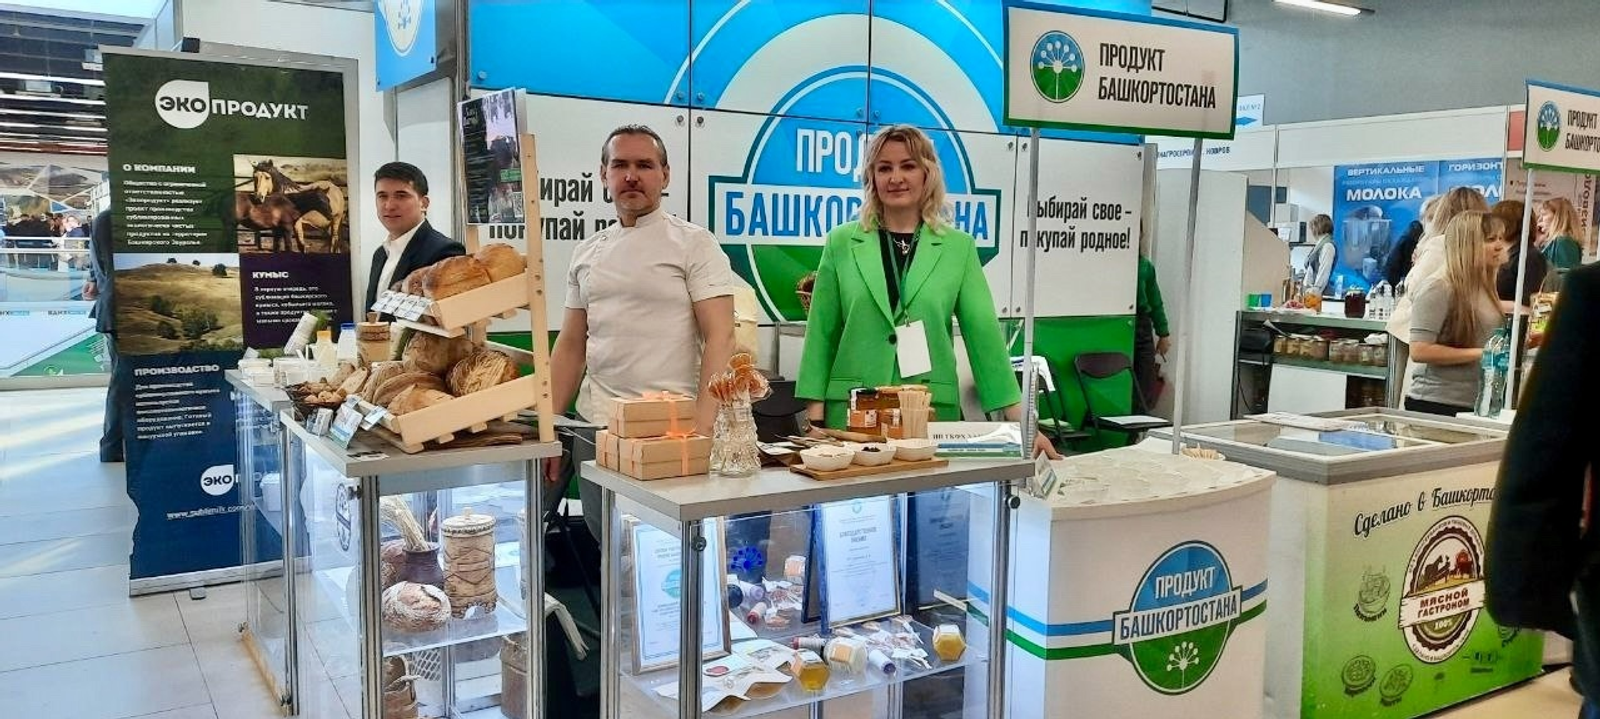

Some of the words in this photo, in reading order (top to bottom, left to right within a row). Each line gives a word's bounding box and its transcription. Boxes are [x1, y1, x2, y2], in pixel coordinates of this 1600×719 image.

[1099, 42, 1166, 73] ПРОДУКТ
[1098, 76, 1216, 109] БАШКОРТОСТАНА
[1567, 110, 1598, 130] ПРОДУКТ
[122, 163, 132, 172] О
[133, 164, 196, 174] КОМПАНИИ
[1347, 165, 1425, 177] ВЕРТИКАЛЬНЫЕ
[1448, 161, 1503, 171] ГОРИЗОНТ
[540, 172, 593, 207] ирай
[1346, 186, 1422, 201] МОЛОКА
[1092, 203, 1122, 221] свое
[1020, 225, 1076, 252] пкупай
[1081, 227, 1131, 253] родное!
[252, 271, 289, 279] КУМЫС
[133, 364, 220, 377] ПРОИЗВОДСТВО
[1354, 501, 1412, 539] Сделано
[1417, 491, 1427, 512] в
[1431, 487, 1495, 508] Башкорто
[1154, 566, 1216, 599] ПРОДУКТ
[1417, 597, 1470, 618] ГАСТРОНОМ
[1420, 587, 1469, 608] МЯСНОЙ
[1120, 594, 1238, 640] БАШКОРТОСТАНА
